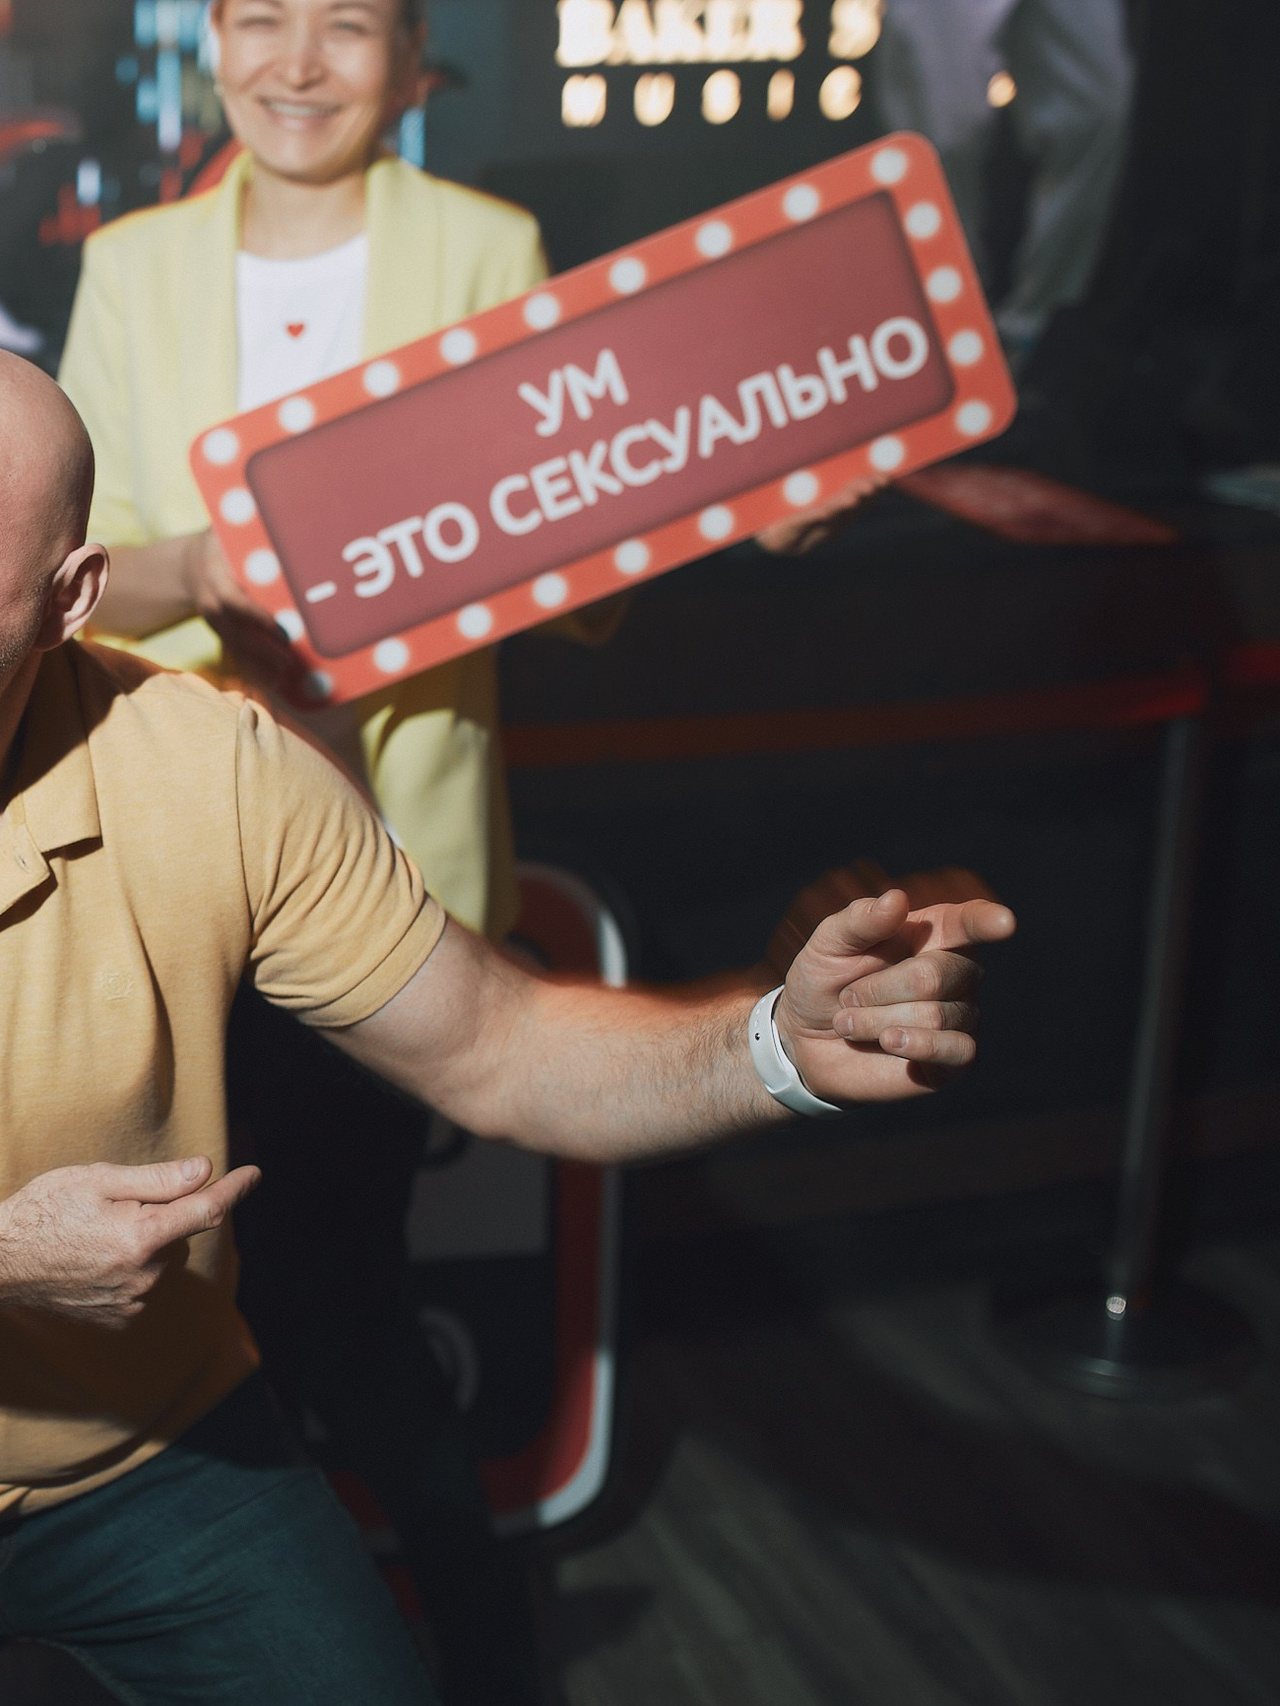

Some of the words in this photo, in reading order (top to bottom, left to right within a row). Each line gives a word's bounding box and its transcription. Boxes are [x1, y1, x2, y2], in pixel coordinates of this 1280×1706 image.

[341, 501, 480, 598] ЭТО
[488, 316, 929, 537] СЕКСУАЛЬНО
[517, 348, 630, 437] УМ
